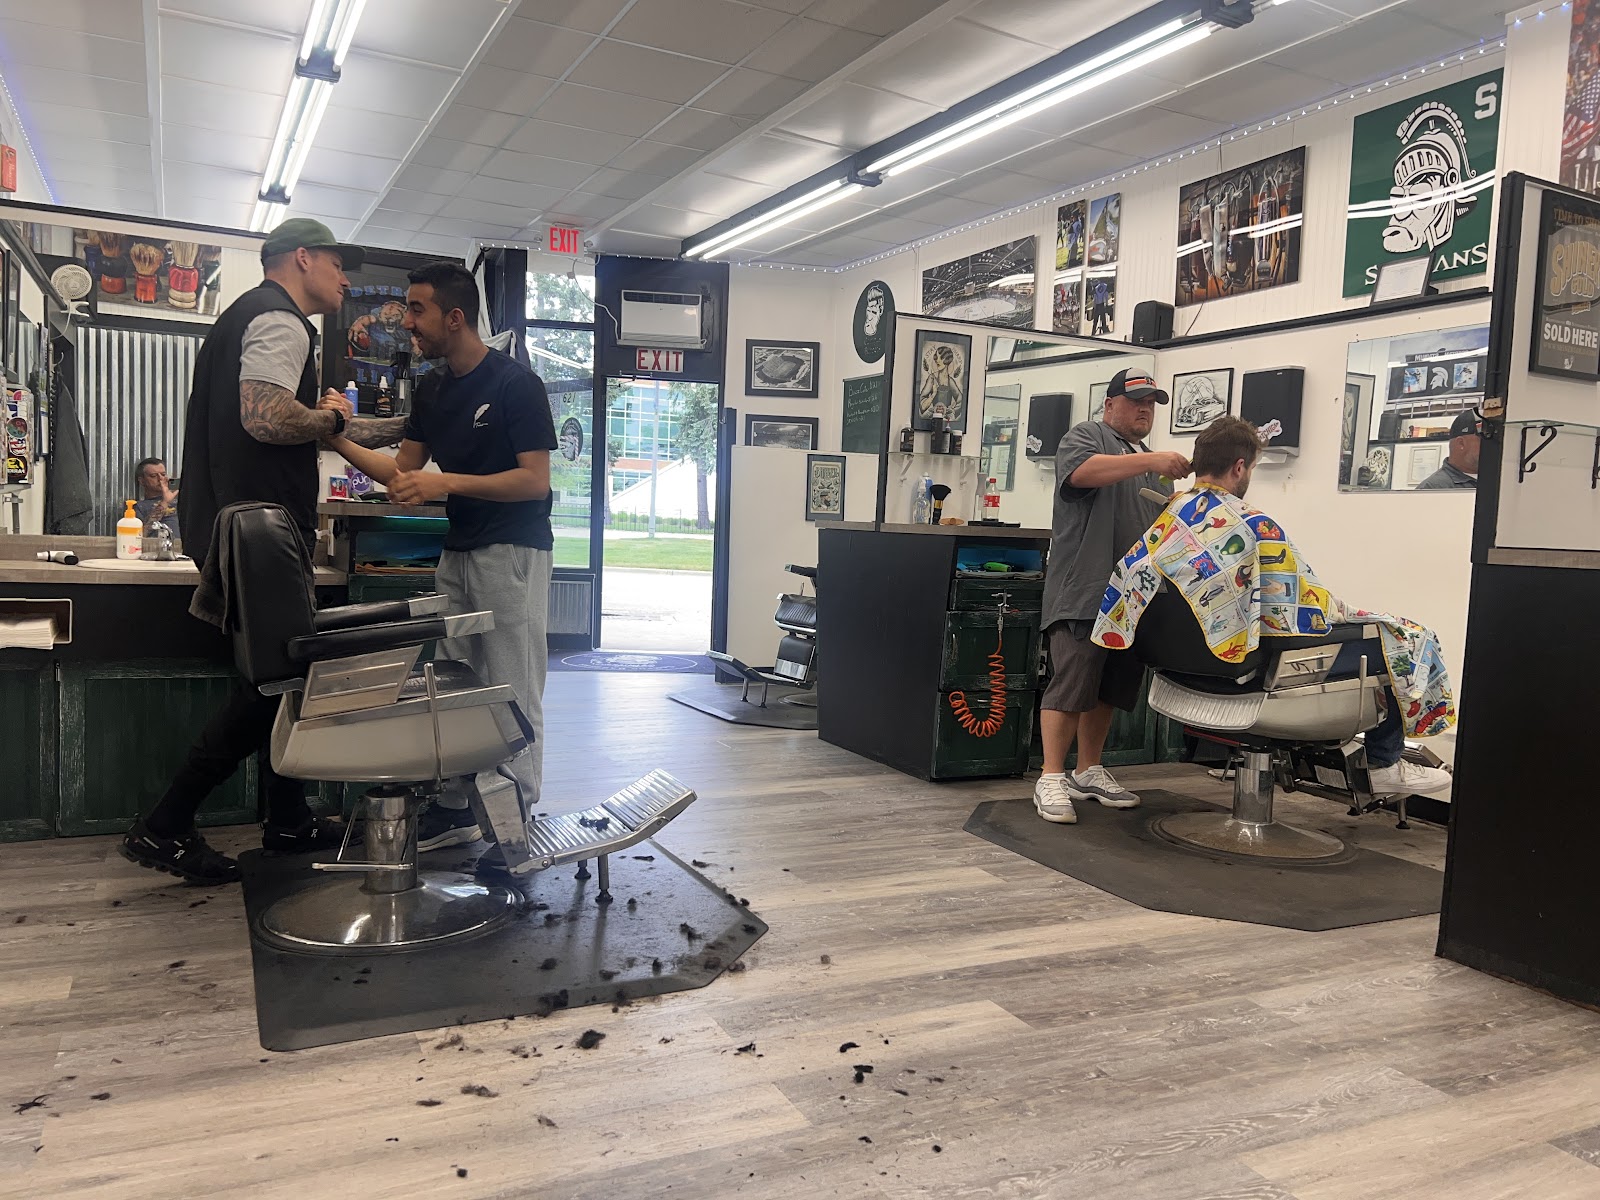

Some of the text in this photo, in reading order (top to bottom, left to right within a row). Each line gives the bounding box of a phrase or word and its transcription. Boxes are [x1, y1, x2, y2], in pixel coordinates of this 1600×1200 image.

[1474, 82, 1498, 120] S
[550, 227, 580, 254] EXIT
[1571, 276, 1595, 298] GOLD
[1543, 322, 1571, 344] SOLD
[1571, 327, 1599, 349] HERE
[637, 349, 683, 372] EXIT
[563, 392, 577, 404] 621
